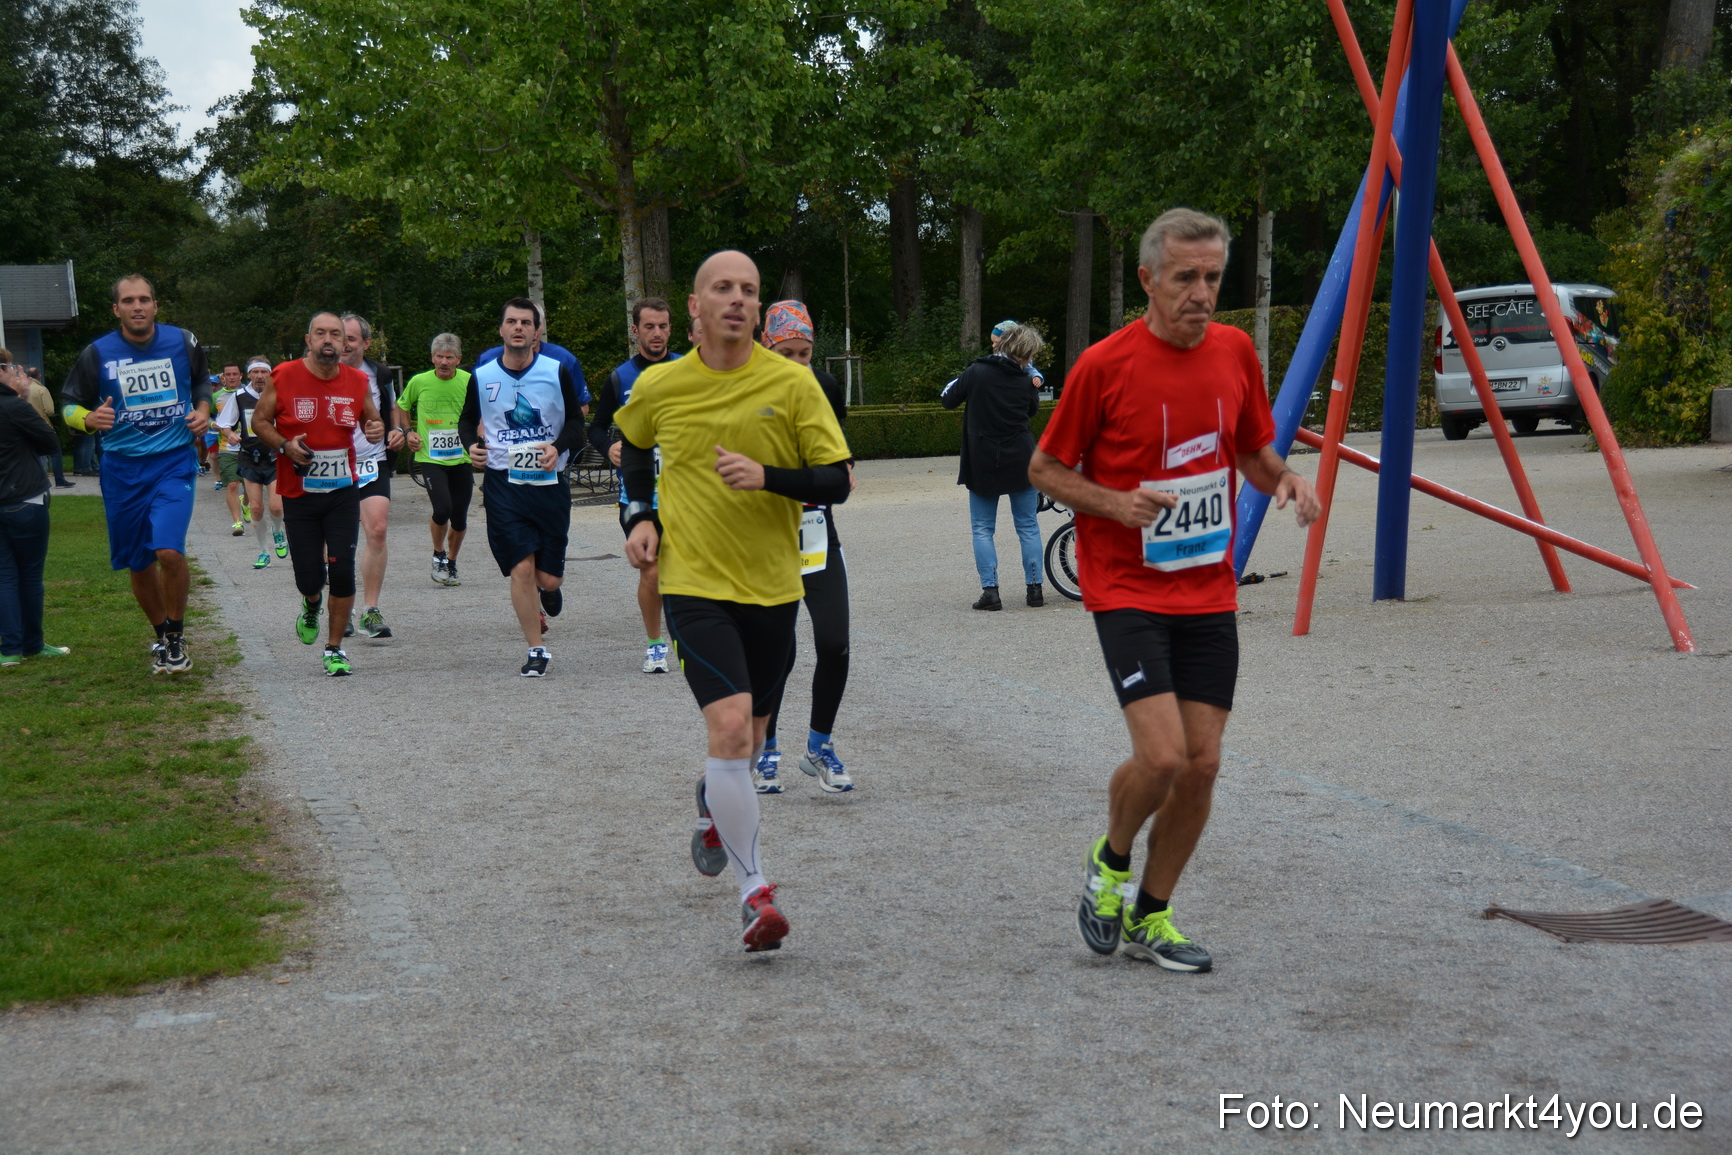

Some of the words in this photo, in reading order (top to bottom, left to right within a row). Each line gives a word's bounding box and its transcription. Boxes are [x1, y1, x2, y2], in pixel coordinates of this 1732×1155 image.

[126, 371, 171, 393] 2019
[141, 395, 163, 403] Simon
[486, 382, 501, 402] 7
[119, 403, 186, 422] FIBALON
[432, 436, 460, 449] 2384
[1181, 443, 1202, 458] DEHN
[309, 460, 347, 476] 2211
[356, 460, 375, 475] 76
[514, 452, 544, 469] 225
[1179, 482, 1217, 497] Neumarkt
[1154, 493, 1222, 537] 2440
[1176, 541, 1207, 557] Franz
